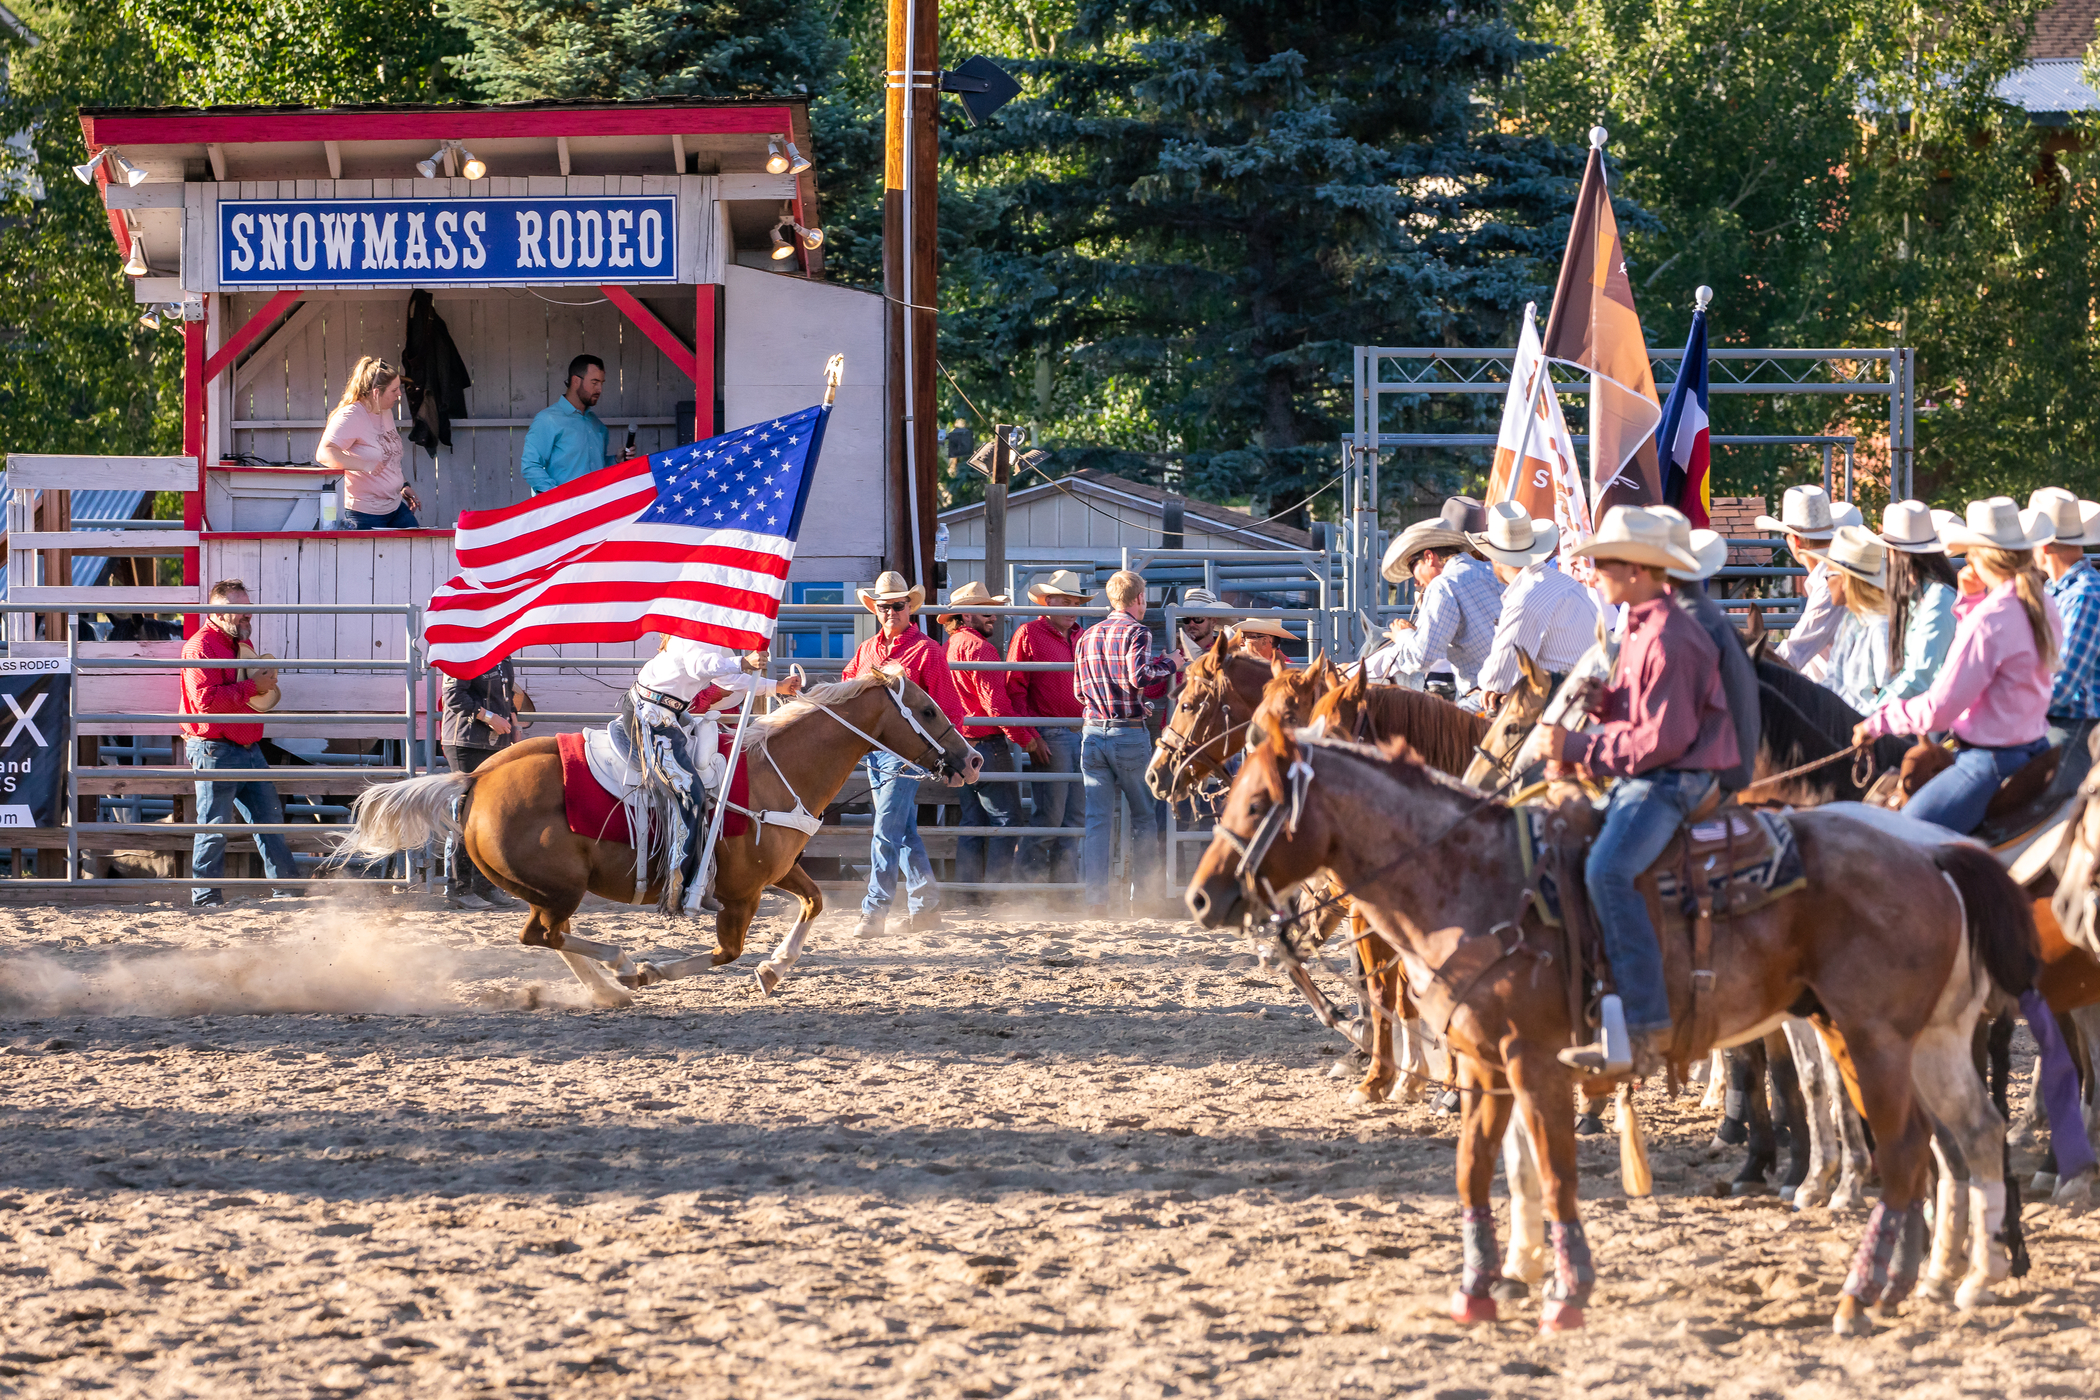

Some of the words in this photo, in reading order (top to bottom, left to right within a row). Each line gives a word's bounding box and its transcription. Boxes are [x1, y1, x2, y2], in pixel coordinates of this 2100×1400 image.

[230, 210, 487, 272] SNOWMASS
[515, 208, 665, 269] RODEO
[19, 659, 60, 670] RODEO
